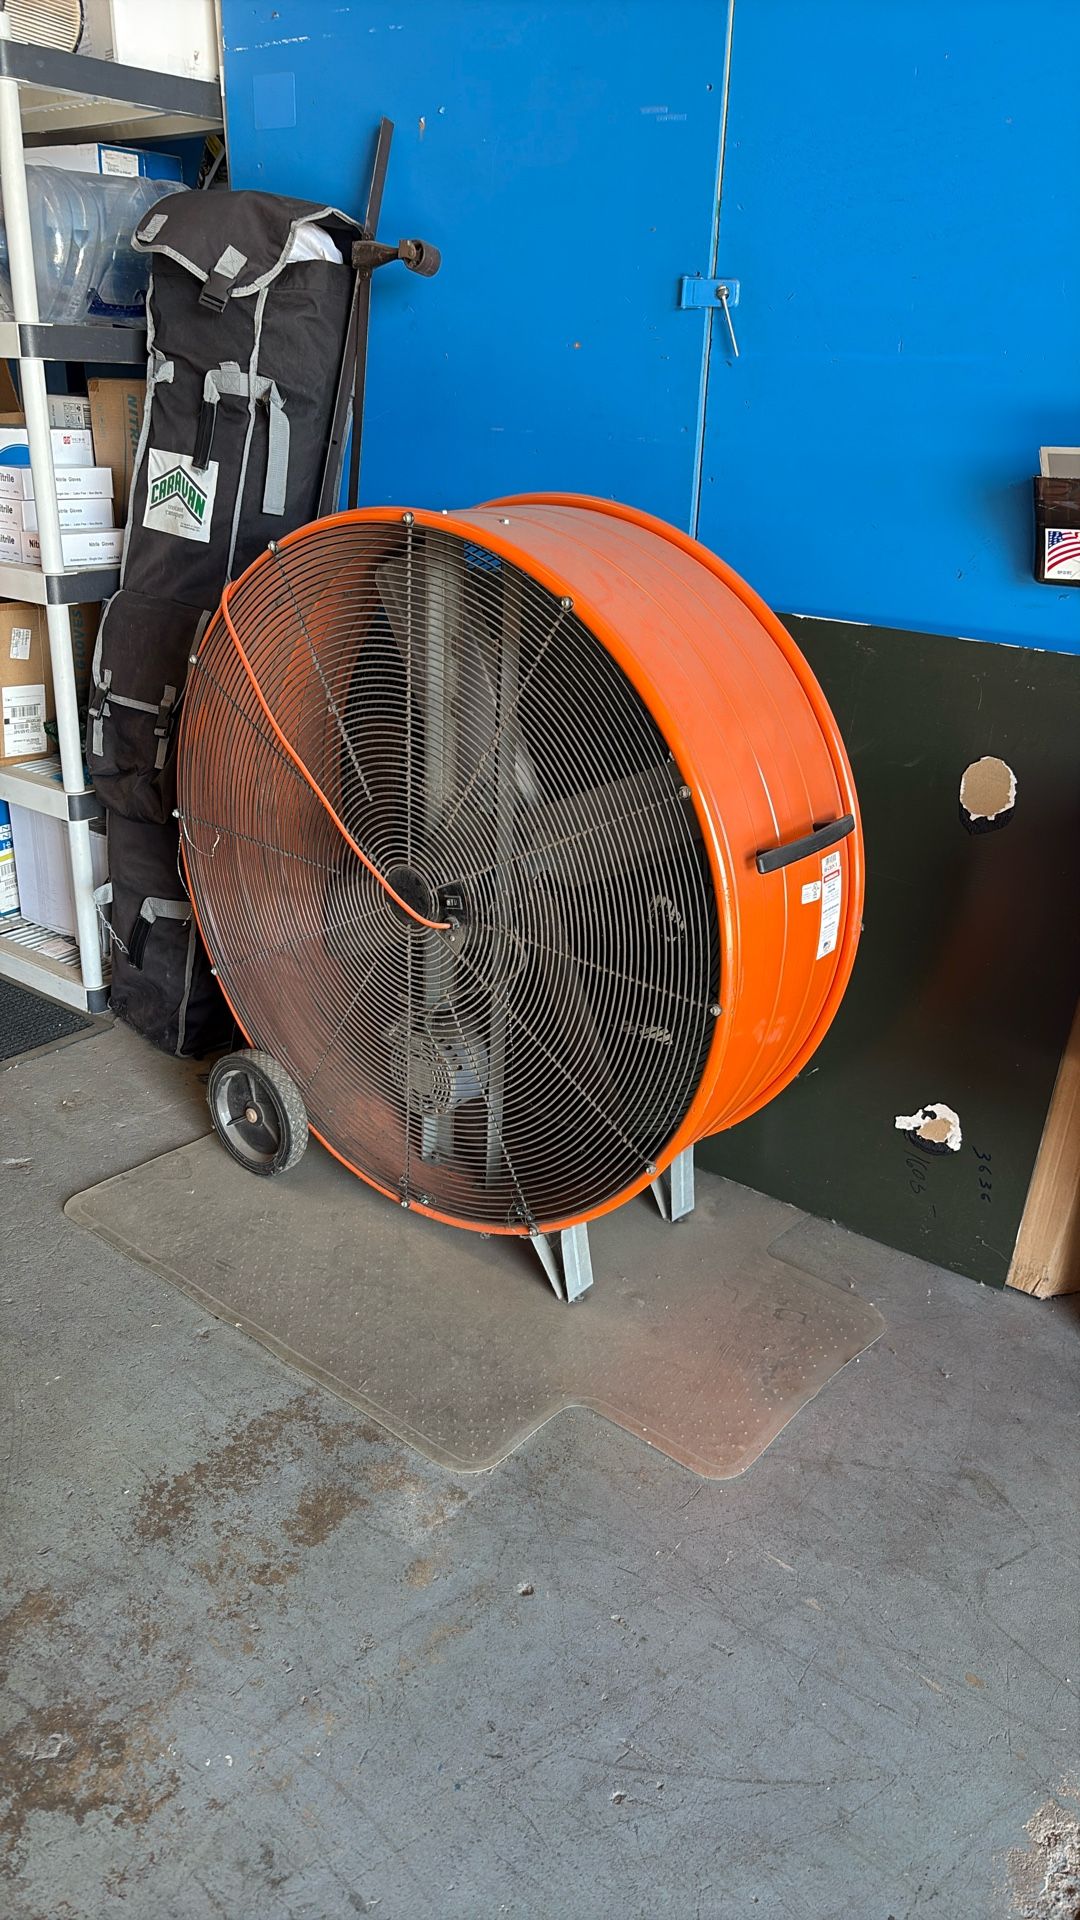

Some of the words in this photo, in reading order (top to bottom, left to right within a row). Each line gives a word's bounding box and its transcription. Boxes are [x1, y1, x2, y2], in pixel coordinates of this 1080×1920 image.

[0, 473, 14, 483] itrile
[151, 470, 206, 519] CARAVAN
[0, 503, 13, 514] itrile
[0, 534, 14, 544] itrile
[972, 1145, 993, 1203] 3636
